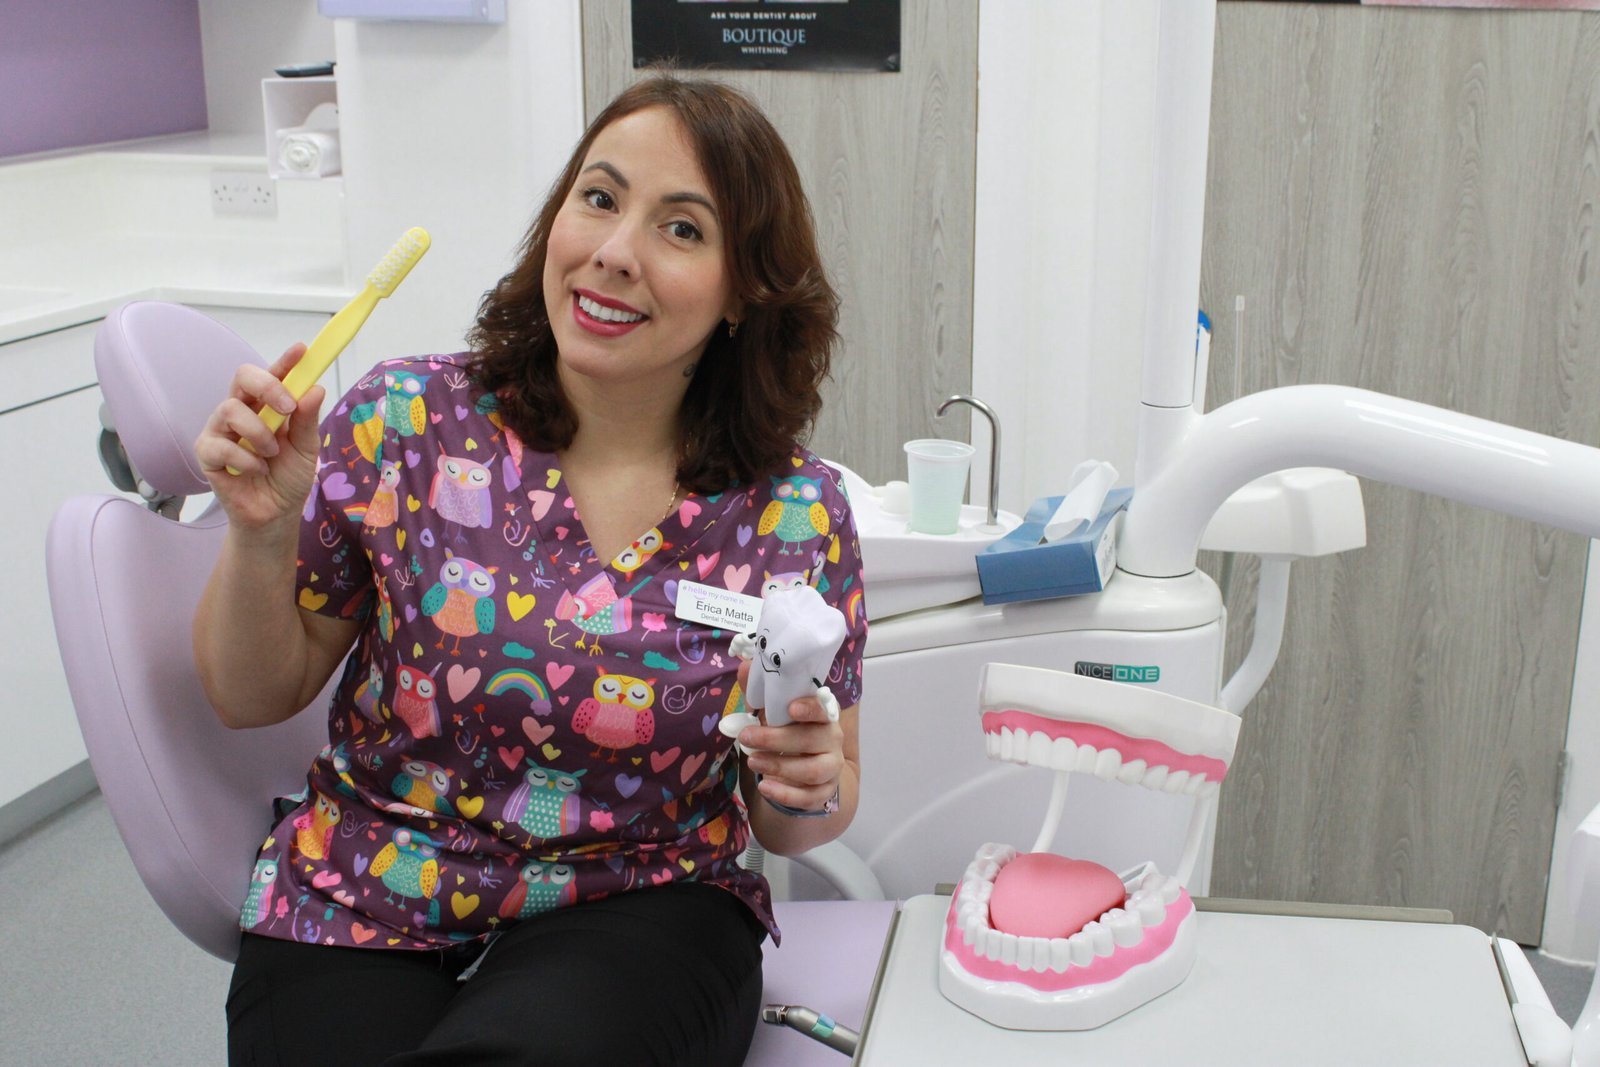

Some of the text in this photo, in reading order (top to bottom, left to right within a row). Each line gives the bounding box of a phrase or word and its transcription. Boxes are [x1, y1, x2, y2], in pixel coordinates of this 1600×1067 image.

[789, 12, 817, 20] ABOUT
[722, 28, 806, 47] BOUTIQUE
[720, 594, 737, 603] name
[696, 600, 754, 622] Erica Matta
[701, 613, 747, 628] Dental Therapist
[1076, 664, 1158, 680] NICE ONE
